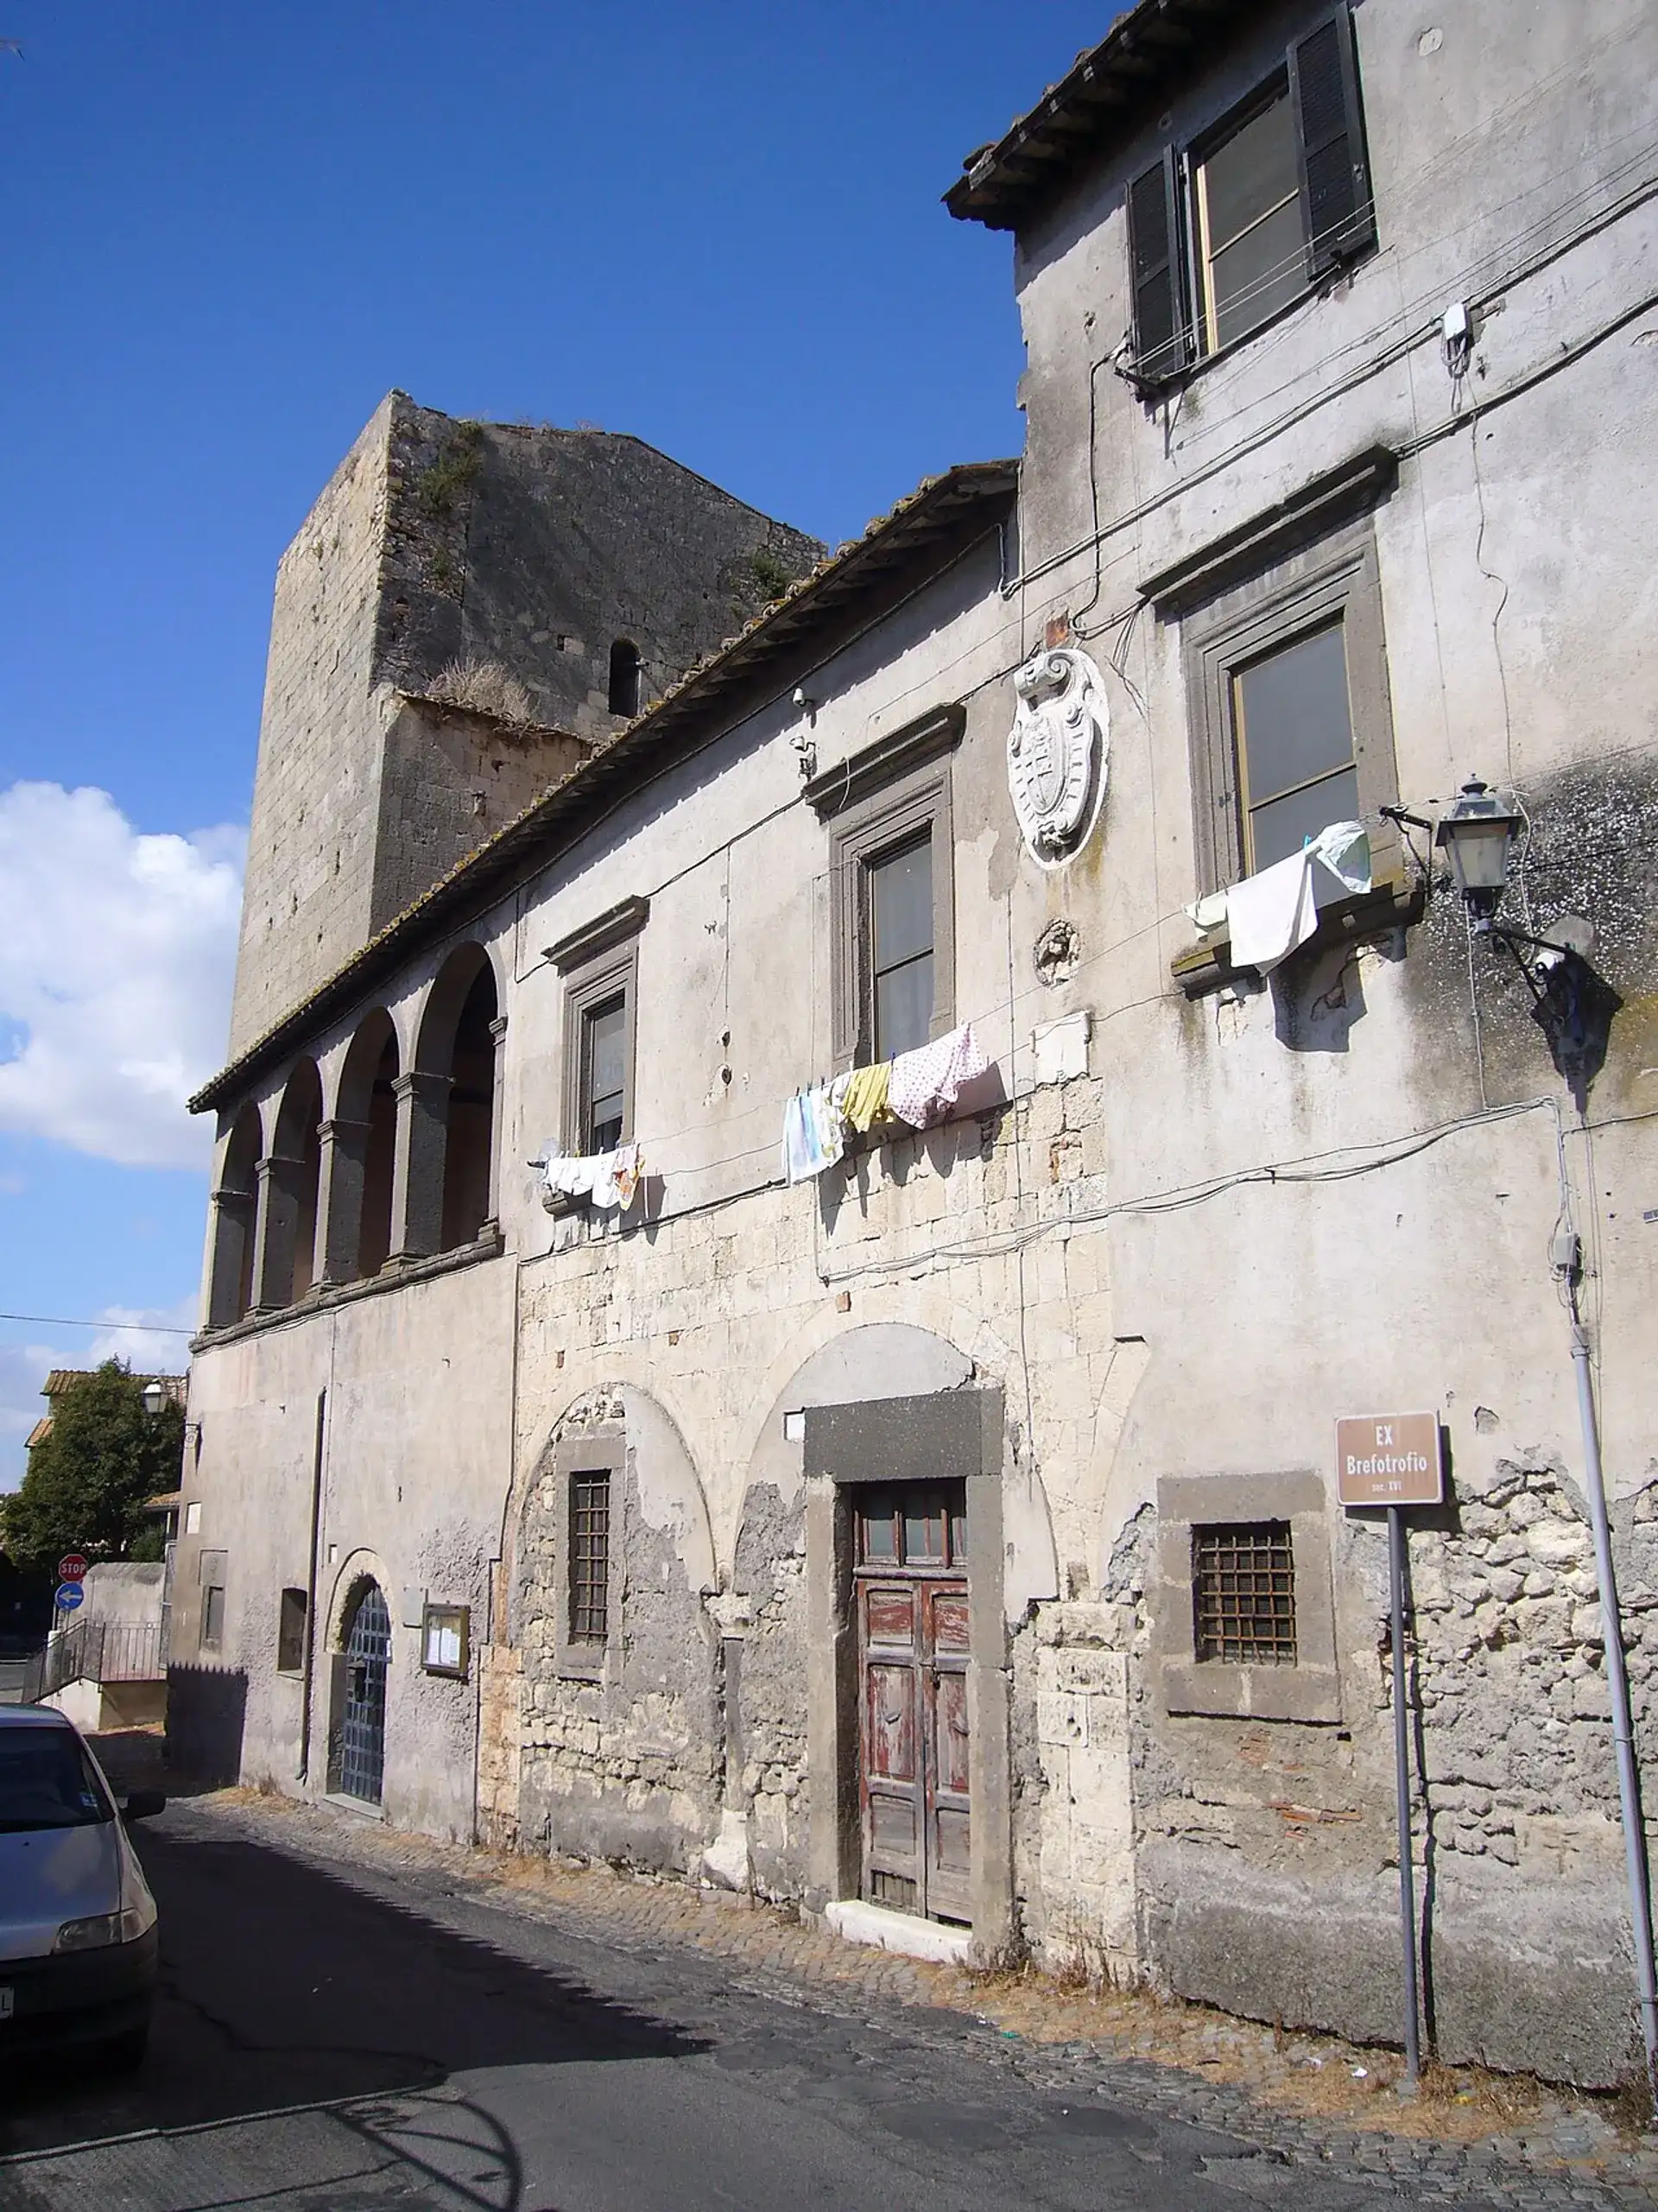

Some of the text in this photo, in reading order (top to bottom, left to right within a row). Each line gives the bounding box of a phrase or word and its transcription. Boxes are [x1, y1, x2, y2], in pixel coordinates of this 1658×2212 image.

[1376, 1425, 1393, 1446] EX
[1346, 1452, 1427, 1474] Brefotrofio
[61, 1563, 85, 1574] STOP
